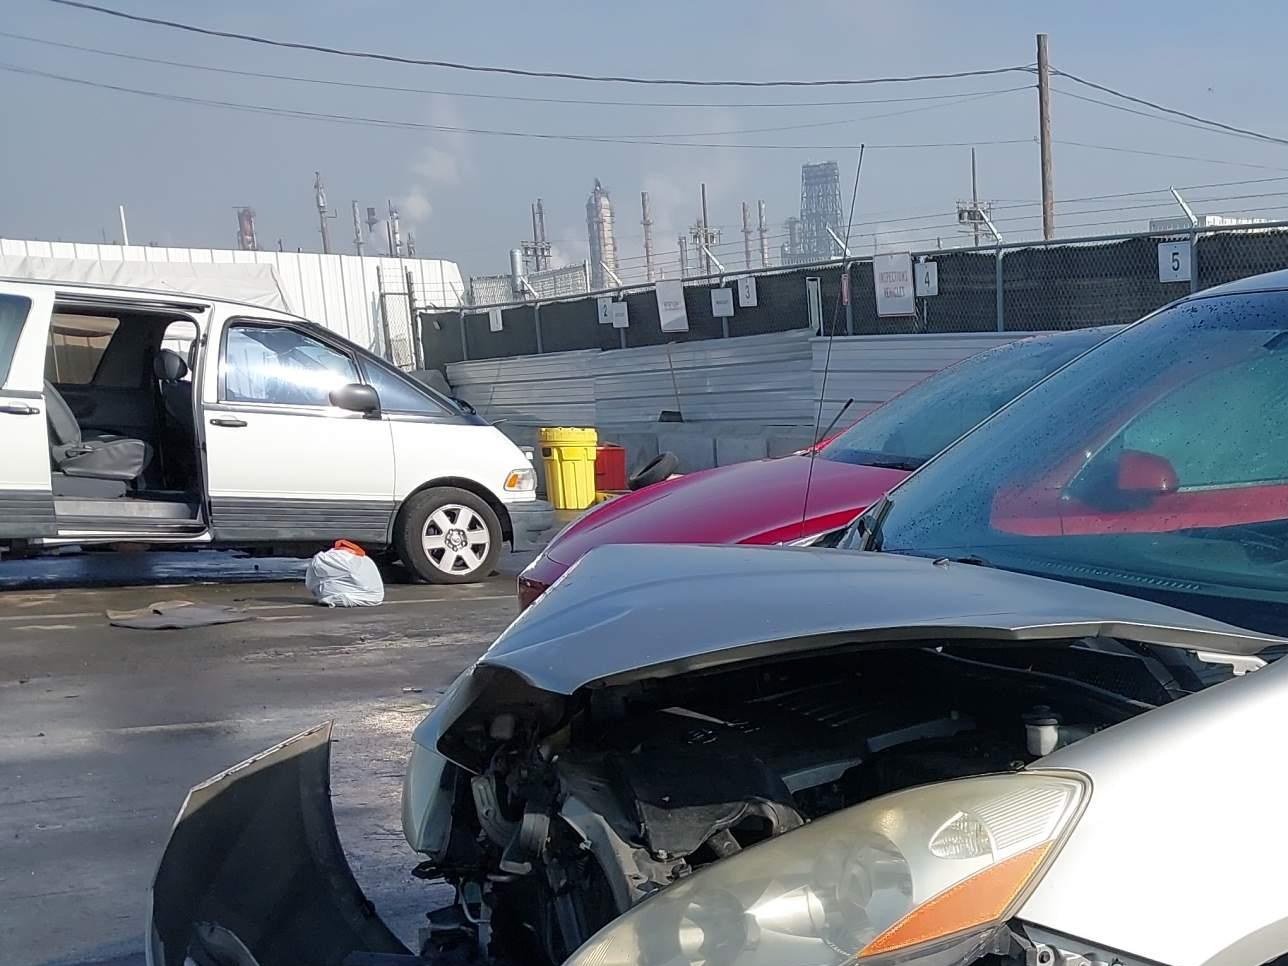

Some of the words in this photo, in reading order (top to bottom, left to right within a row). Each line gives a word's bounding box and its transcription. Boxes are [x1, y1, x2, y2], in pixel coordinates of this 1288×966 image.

[1172, 252, 1180, 271] 5
[924, 271, 931, 288] 4
[744, 285, 751, 300] 3
